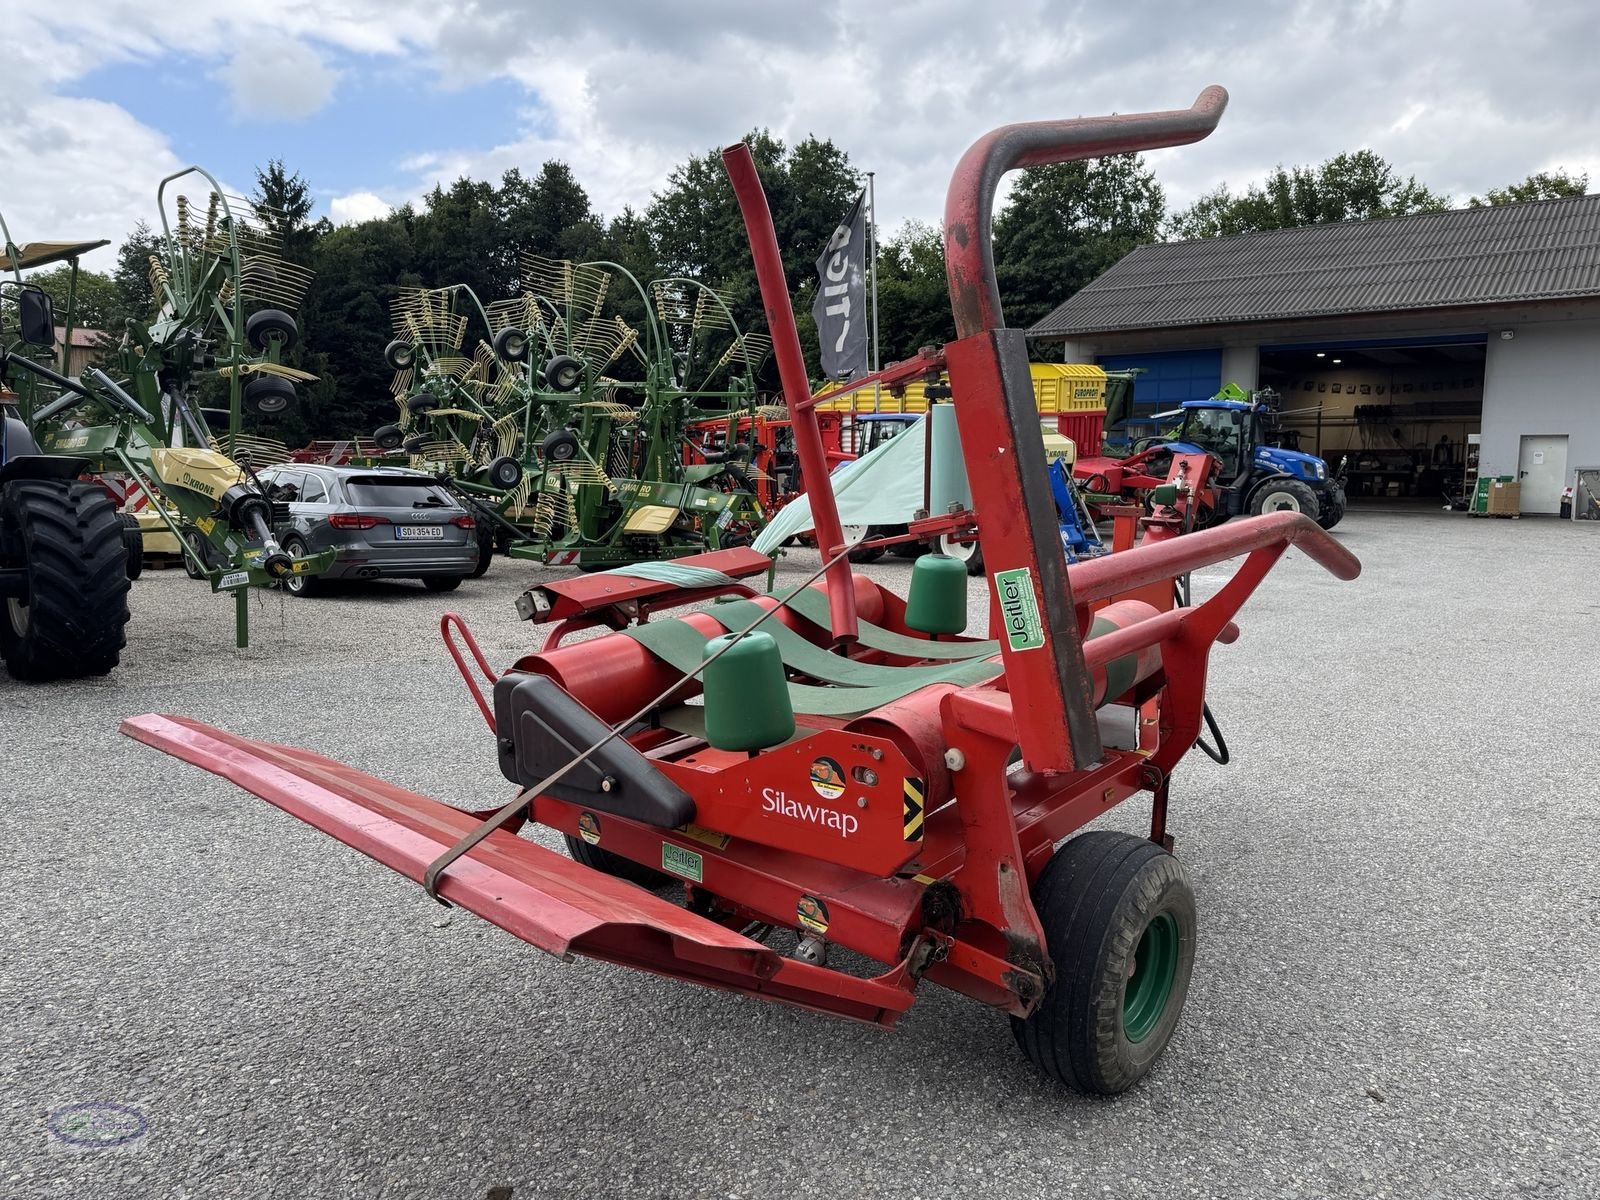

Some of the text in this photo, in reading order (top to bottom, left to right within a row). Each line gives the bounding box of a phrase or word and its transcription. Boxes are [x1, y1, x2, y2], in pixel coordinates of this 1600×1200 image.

[1049, 450, 1068, 458] KRONE
[189, 477, 215, 496] KRONE
[620, 483, 652, 493] SWARO
[402, 527, 412, 536] SD
[1003, 579, 1028, 643] Jeitler
[762, 788, 858, 838] Silawrap
[665, 846, 699, 868] Jeitler
